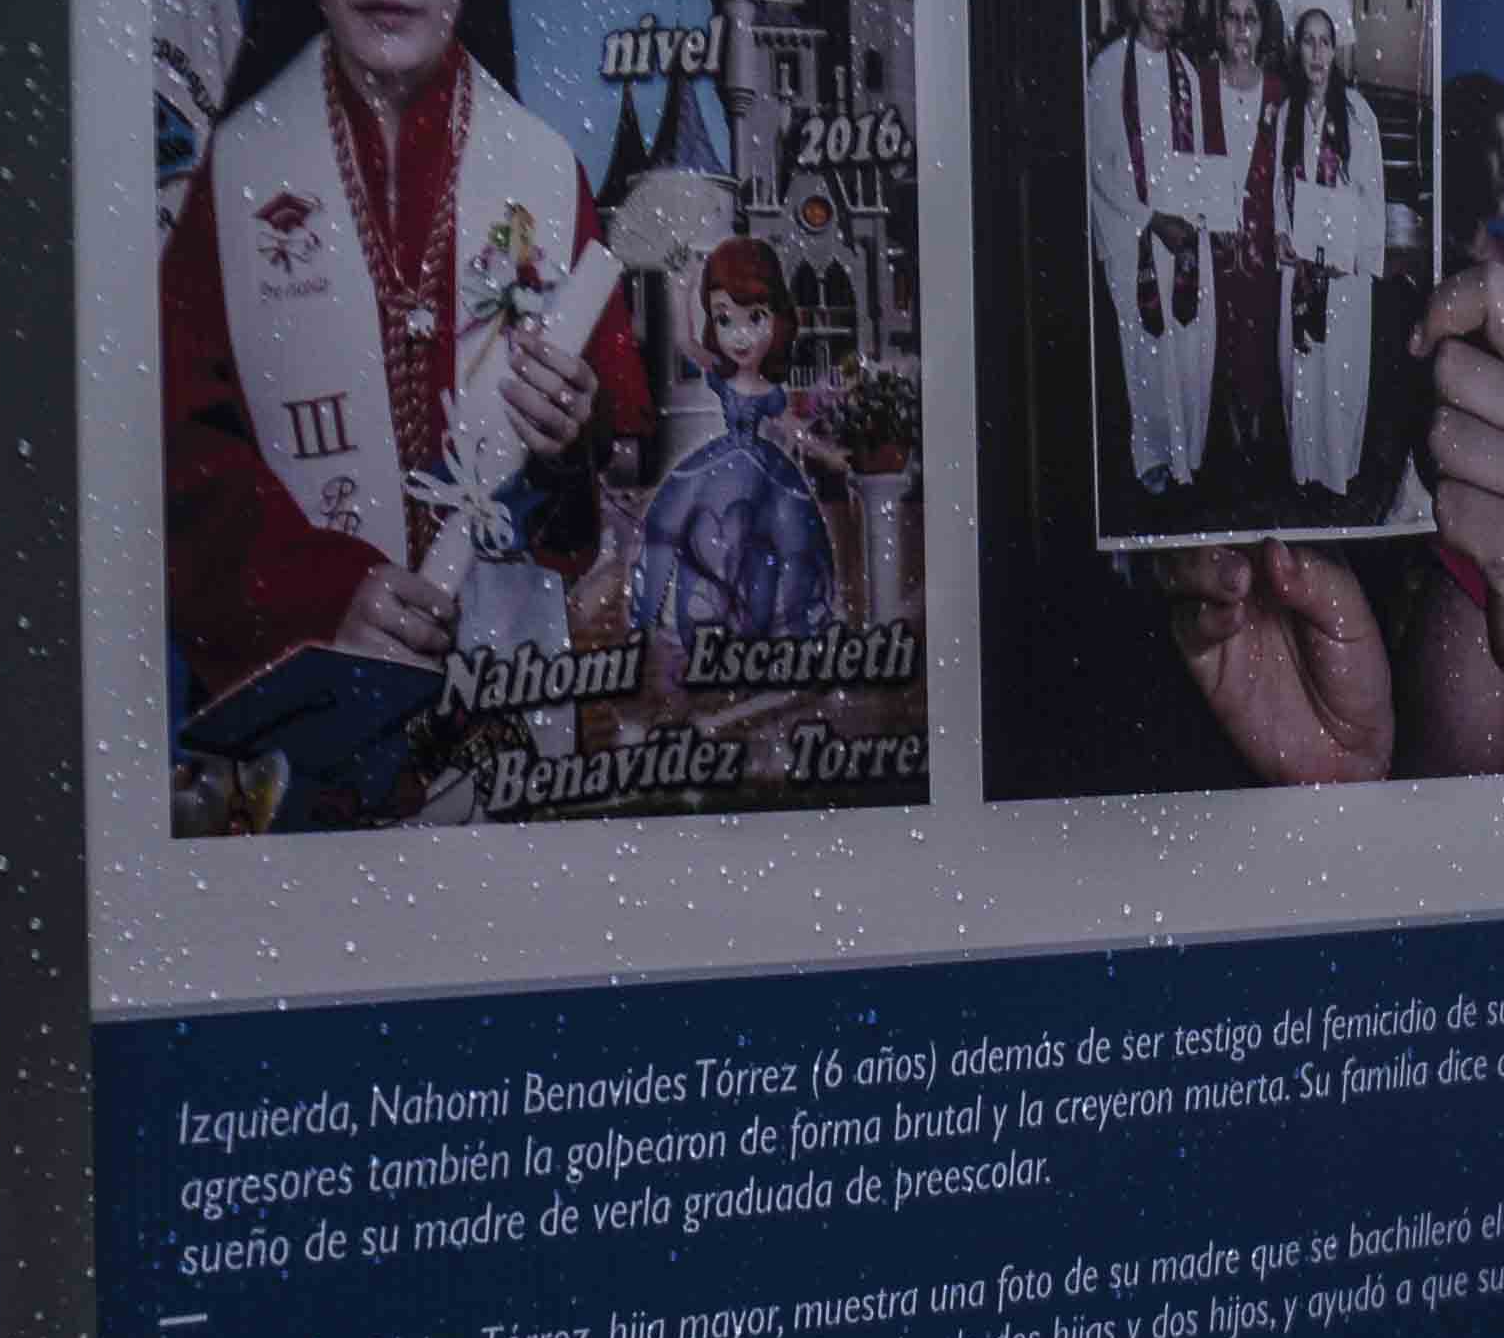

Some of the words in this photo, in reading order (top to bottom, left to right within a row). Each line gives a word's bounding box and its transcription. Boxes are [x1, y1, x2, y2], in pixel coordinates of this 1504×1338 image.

[602, 16, 723, 80] nivel
[283, 391, 357, 459] III
[436, 630, 642, 716] Nahomi
[687, 622, 915, 683] Escarleth
[495, 727, 742, 808] Benavidez
[792, 724, 928, 781] Torre
[178, 1089, 359, 1155] Izquierda,
[368, 1076, 511, 1129] Nahomi
[522, 1063, 689, 1115] Benavides
[699, 1056, 799, 1100] Tórrez
[811, 1047, 844, 1099] (6
[855, 1040, 937, 1085] años)
[950, 1030, 1066, 1077] además
[1075, 1025, 1112, 1065] de
[1120, 1031, 1166, 1061] ser
[1174, 1016, 1263, 1060] testigo
[1272, 1006, 1314, 1047] del
[1321, 996, 1438, 1052] femicidio
[1446, 992, 1478, 1031] de
[179, 1165, 354, 1222] agresores
[368, 1139, 510, 1195] también
[523, 1135, 554, 1178] la
[564, 1127, 727, 1186] golpearon
[739, 1113, 778, 1157] de
[789, 1109, 882, 1163] forma
[893, 1093, 983, 1143] brutal
[991, 1103, 1009, 1143] y
[1017, 1088, 1044, 1130] la
[1054, 1085, 1174, 1133] creyeron
[1183, 1073, 1293, 1113] muerta.
[1296, 1060, 1331, 1100] Su
[1340, 1051, 1429, 1105] familia
[1436, 1047, 1489, 1085] dice
[179, 1227, 291, 1277] sueño
[303, 1218, 348, 1263] de
[361, 1224, 400, 1257] su
[413, 1201, 526, 1251] madre
[538, 1194, 580, 1238] de
[592, 1184, 673, 1231] verla
[681, 1168, 834, 1235] graduada
[844, 1164, 883, 1206] de
[893, 1148, 1052, 1212] preescolar.
[793, 1286, 920, 1330] muestra
[929, 1278, 986, 1312] una
[996, 1263, 1053, 1313] foto
[1063, 1254, 1099, 1295] de
[1108, 1260, 1141, 1289] su
[1150, 1238, 1241, 1284] madre
[1250, 1240, 1301, 1279] que
[1309, 1233, 1339, 1263] se
[1347, 1206, 1473, 1259] bachilleró
[1480, 1201, 1504, 1241] el
[1282, 1295, 1299, 1332] y
[1307, 1272, 1386, 1327] ayudó
[1395, 1278, 1412, 1306] a
[1421, 1271, 1469, 1311] que
[1477, 1266, 1504, 1294] su
